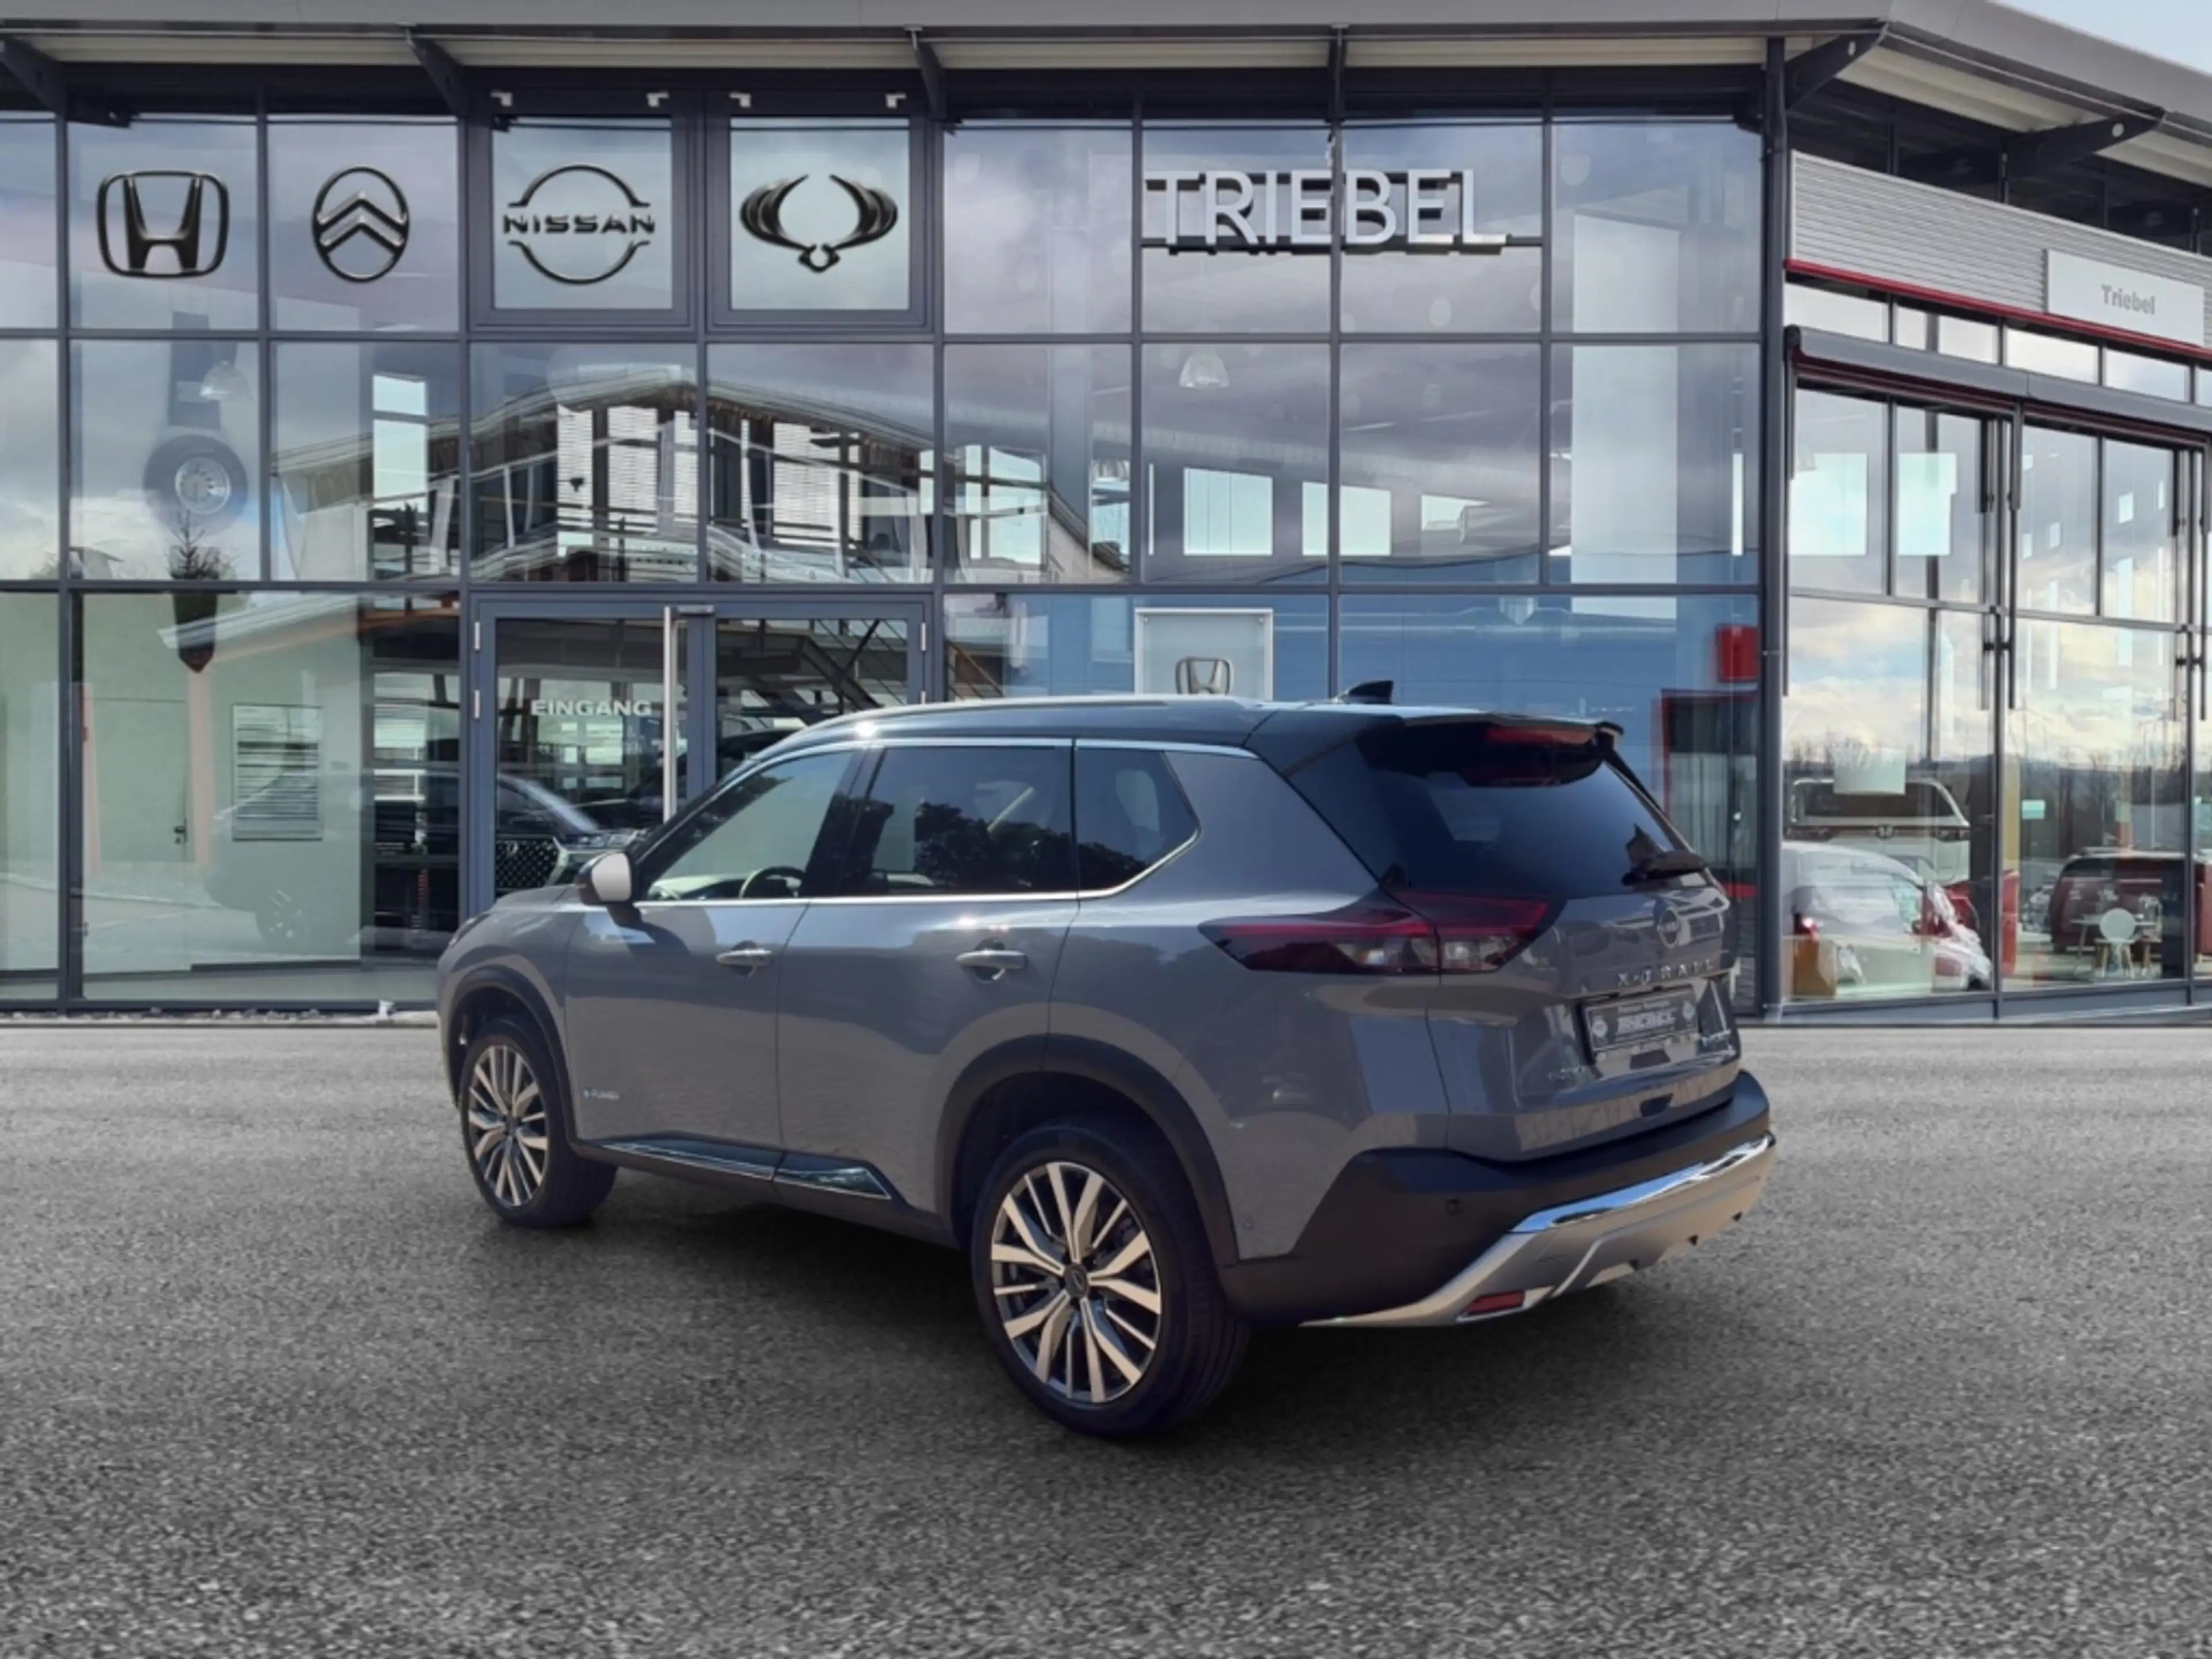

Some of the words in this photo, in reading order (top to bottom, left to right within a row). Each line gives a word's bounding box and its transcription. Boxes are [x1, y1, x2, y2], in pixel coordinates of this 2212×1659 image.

[1145, 169, 1506, 248] TRIEBEL
[503, 214, 656, 234] NISSAN
[2101, 283, 2156, 315] Triebel
[531, 699, 652, 716] EINGANG
